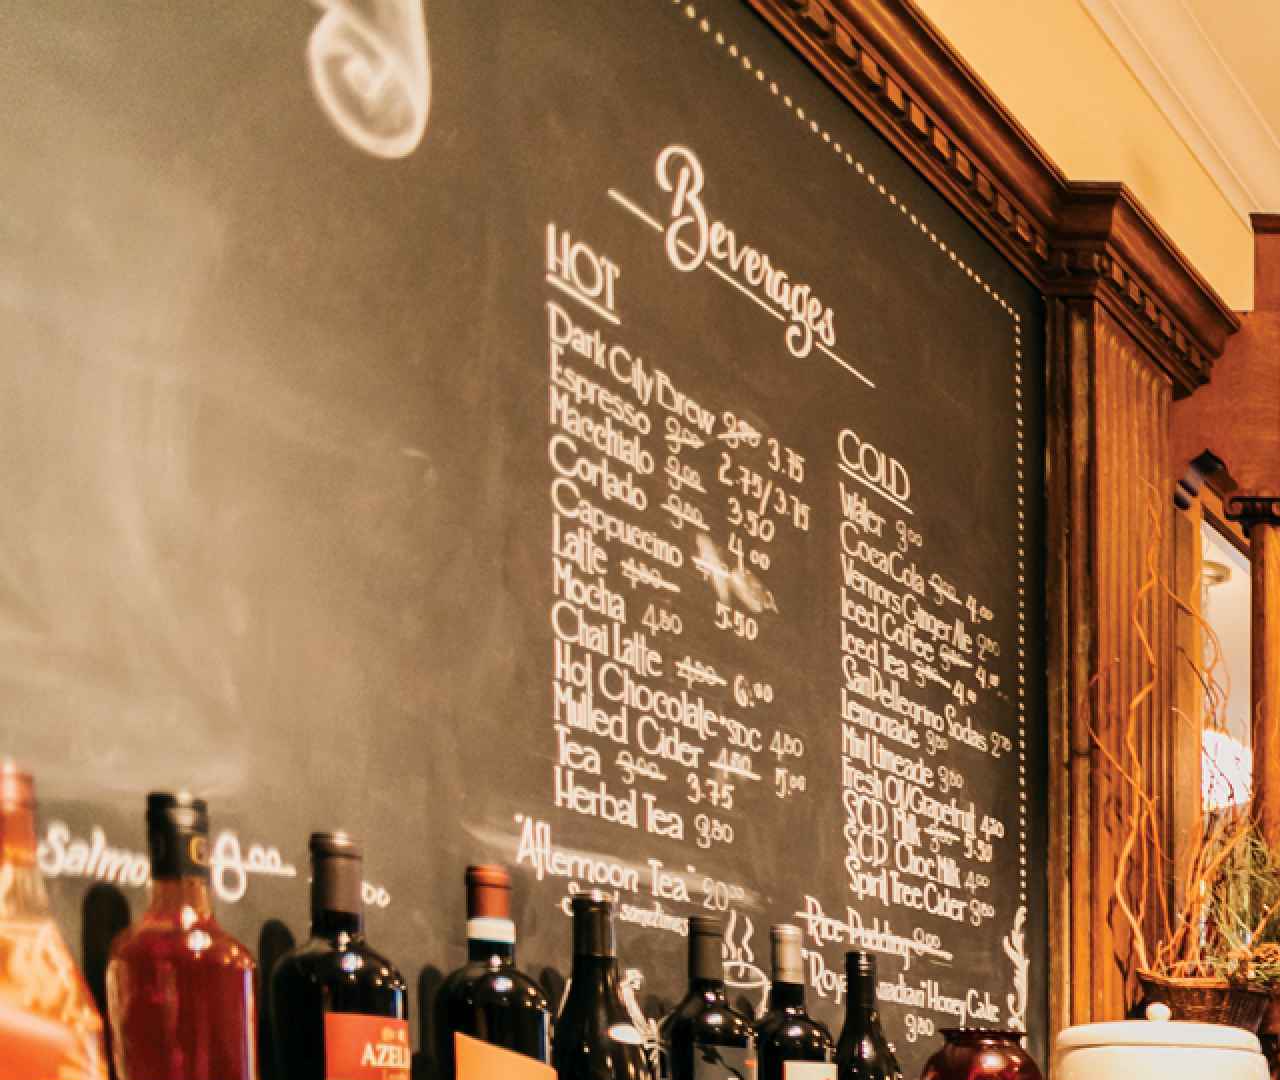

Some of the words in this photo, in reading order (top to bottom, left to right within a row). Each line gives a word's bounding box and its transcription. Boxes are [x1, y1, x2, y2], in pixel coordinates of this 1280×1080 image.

[547, 224, 620, 311] HOT
[657, 145, 836, 357] Beverages
[547, 300, 607, 369] Dark
[608, 346, 654, 406] City
[550, 342, 651, 435] Espresso
[549, 384, 655, 475] Macchiato
[837, 429, 912, 502] COLD
[549, 434, 648, 511] Cortado
[551, 512, 608, 576] Latte
[552, 557, 627, 625] Mocha
[551, 599, 610, 657] Chai
[612, 621, 664, 677] Latte
[552, 638, 593, 701] Hot
[599, 661, 719, 741] Chocolate
[552, 680, 629, 745] Mulled
[637, 714, 705, 769] Cider
[554, 722, 601, 774] Tea
[553, 765, 639, 830] Herbal
[641, 791, 686, 842] Tea
[37, 820, 151, 887] Salmo
